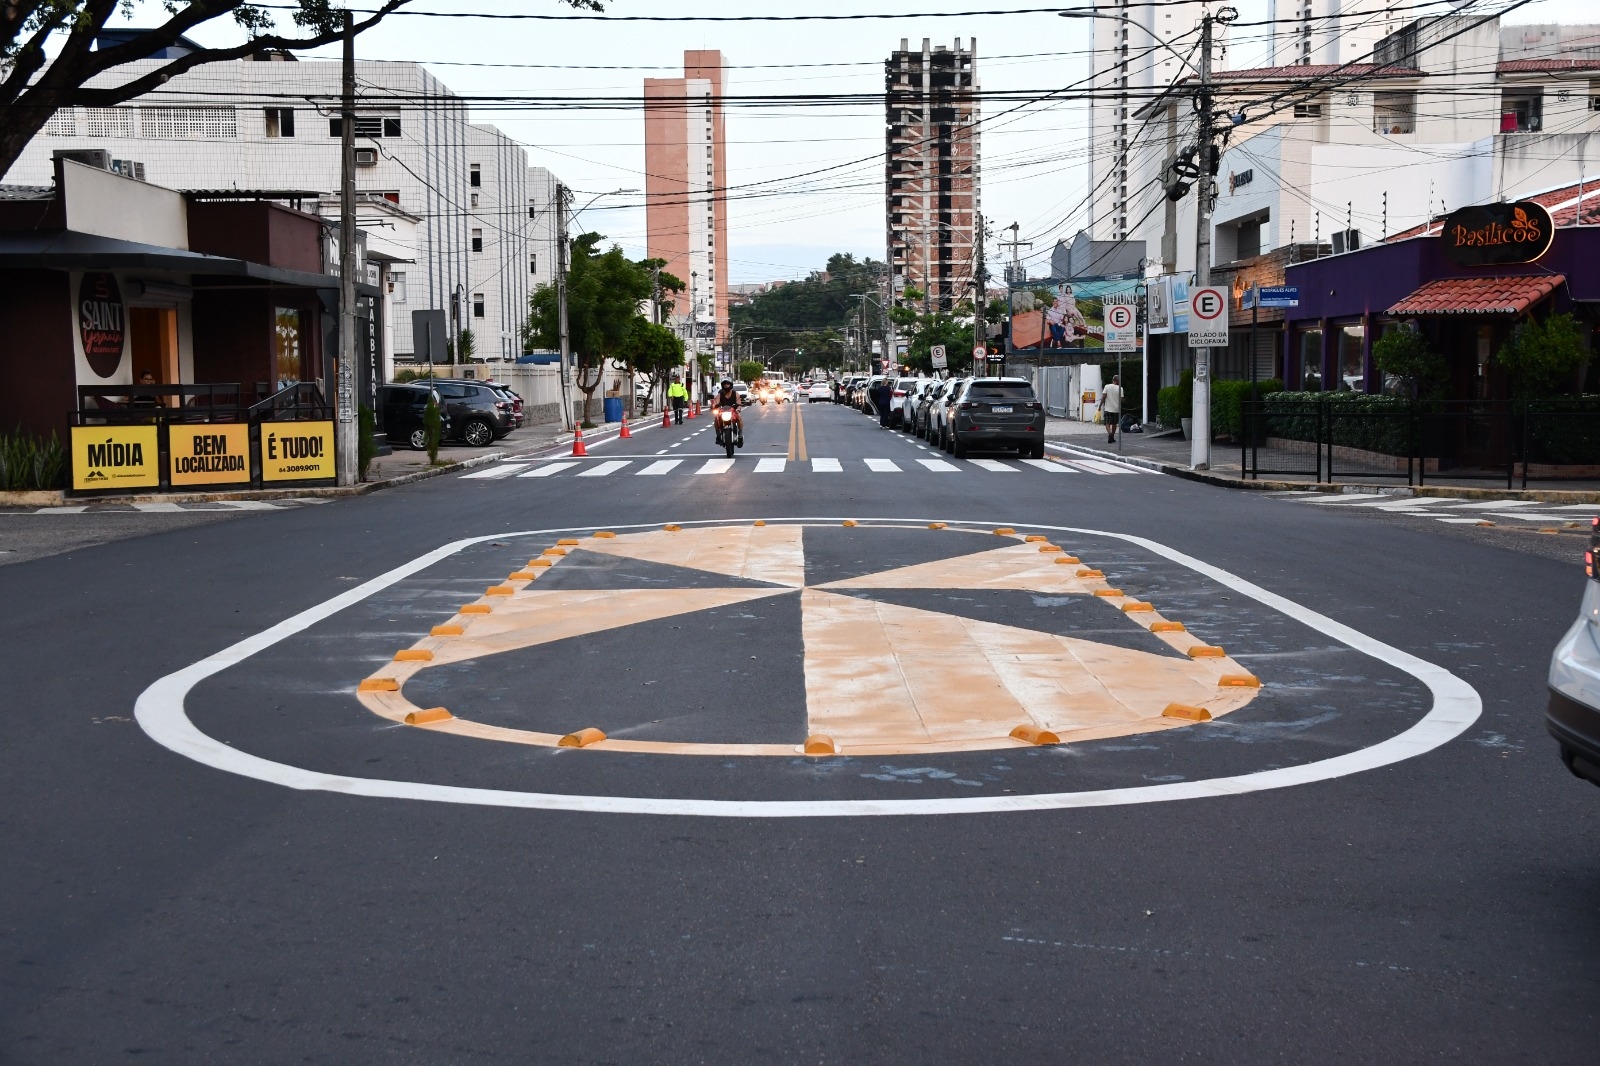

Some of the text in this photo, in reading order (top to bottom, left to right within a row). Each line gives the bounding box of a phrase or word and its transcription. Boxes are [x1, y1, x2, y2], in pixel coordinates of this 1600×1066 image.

[1202, 297, 1214, 312] E
[82, 299, 122, 332] SAINT
[1115, 311, 1125, 323] E
[87, 437, 144, 468] MÍDIA
[193, 434, 227, 456] BEM
[267, 432, 324, 460] É TUDO!
[175, 455, 245, 474] LOCALIZADA
[286, 464, 320, 473] 3089.9011
